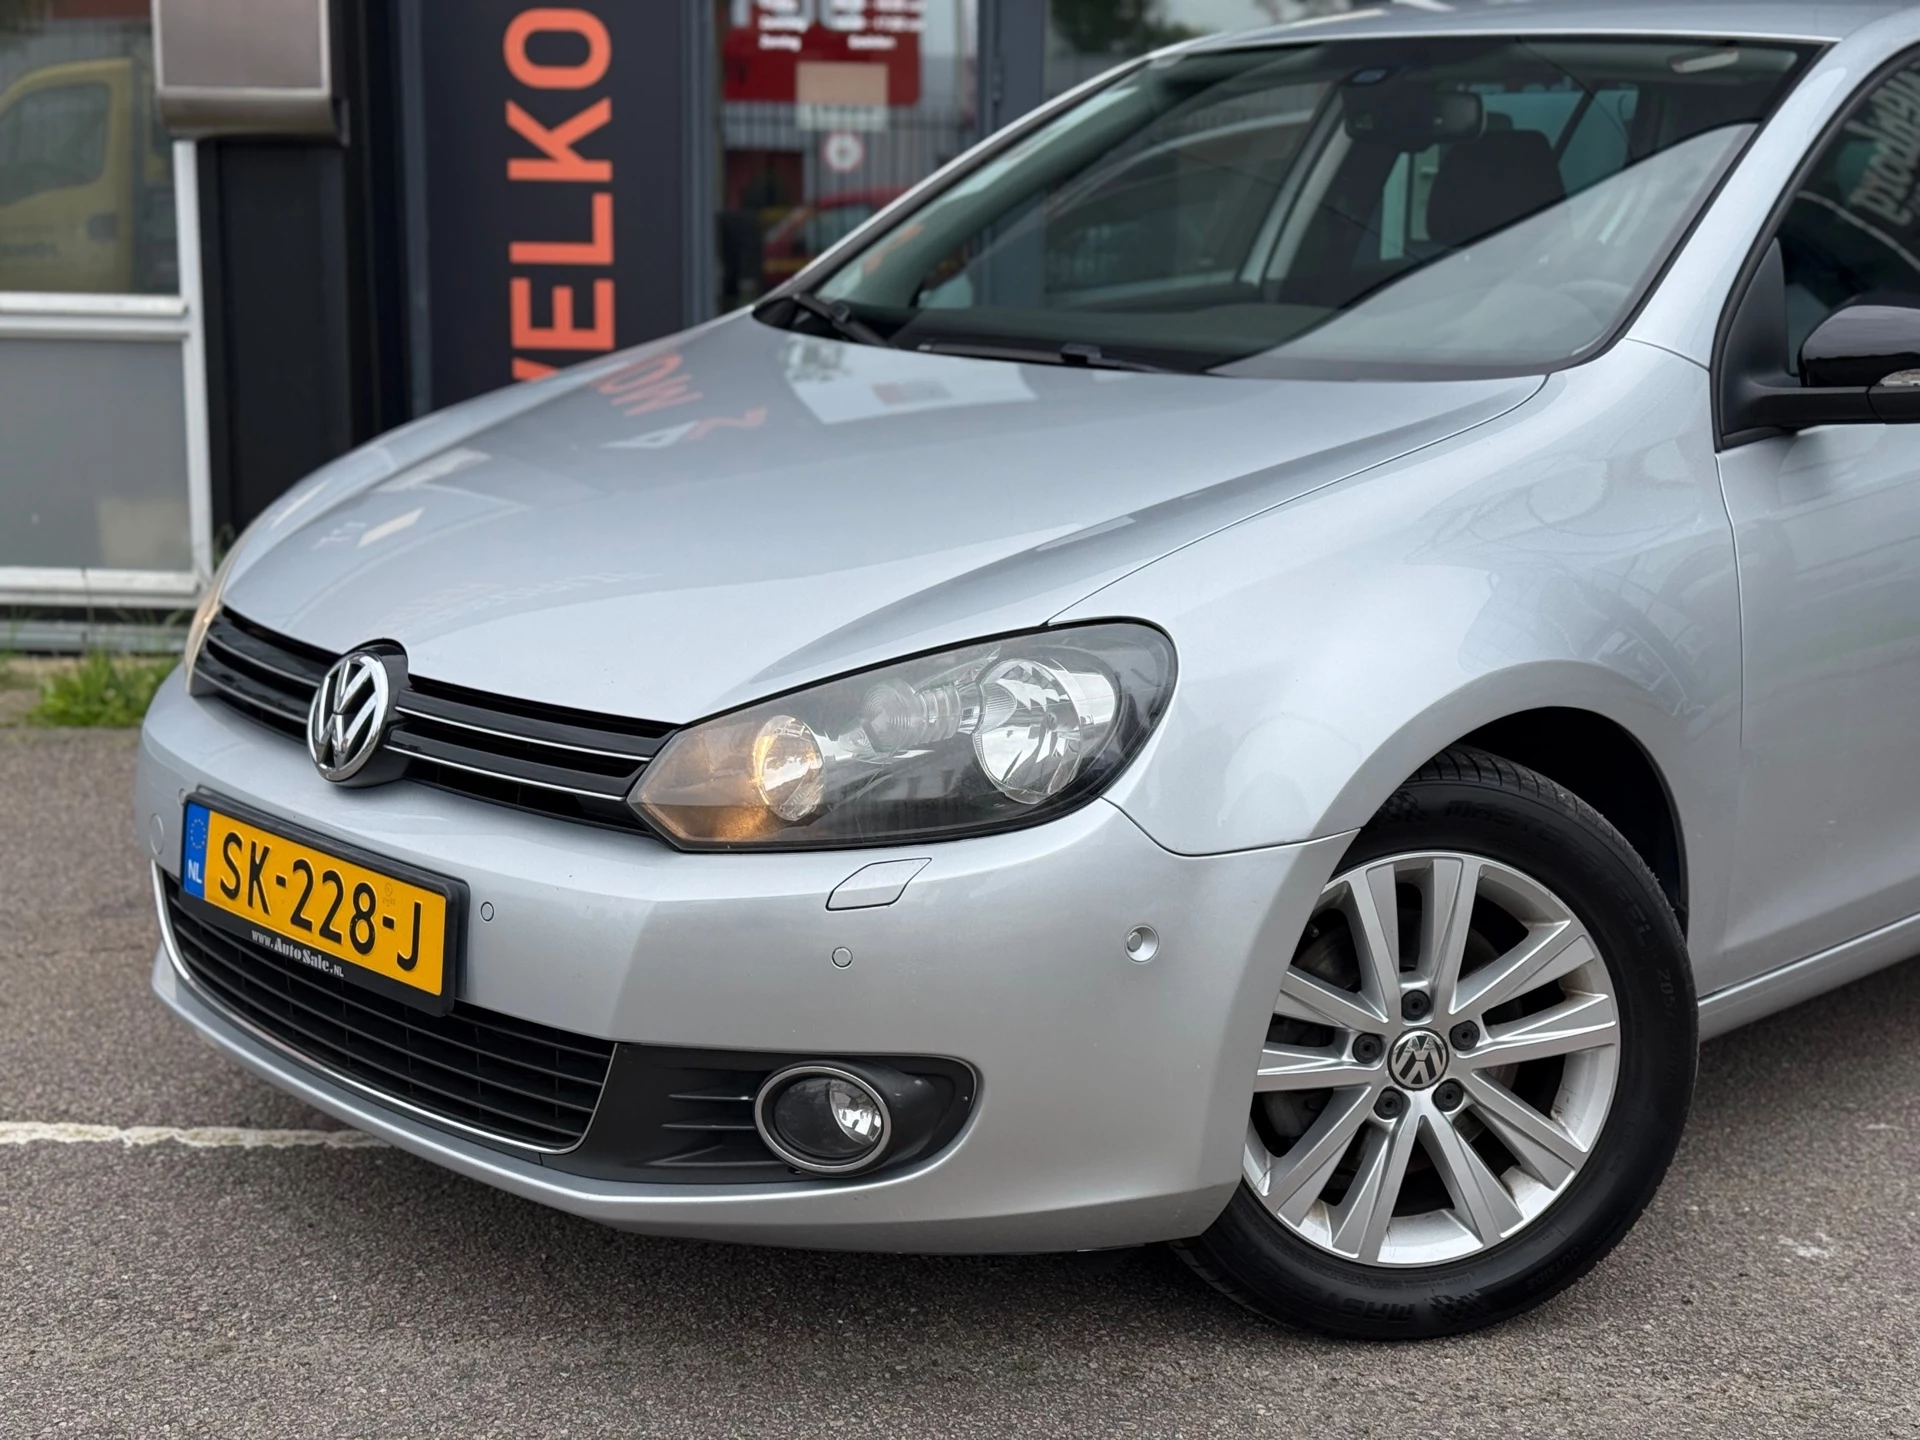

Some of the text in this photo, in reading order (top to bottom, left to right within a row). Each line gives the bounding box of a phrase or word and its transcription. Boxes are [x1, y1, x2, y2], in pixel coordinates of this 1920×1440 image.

[503, 8, 614, 382] ELKO
[187, 860, 203, 884] NL
[219, 831, 422, 971] SK-228-J
